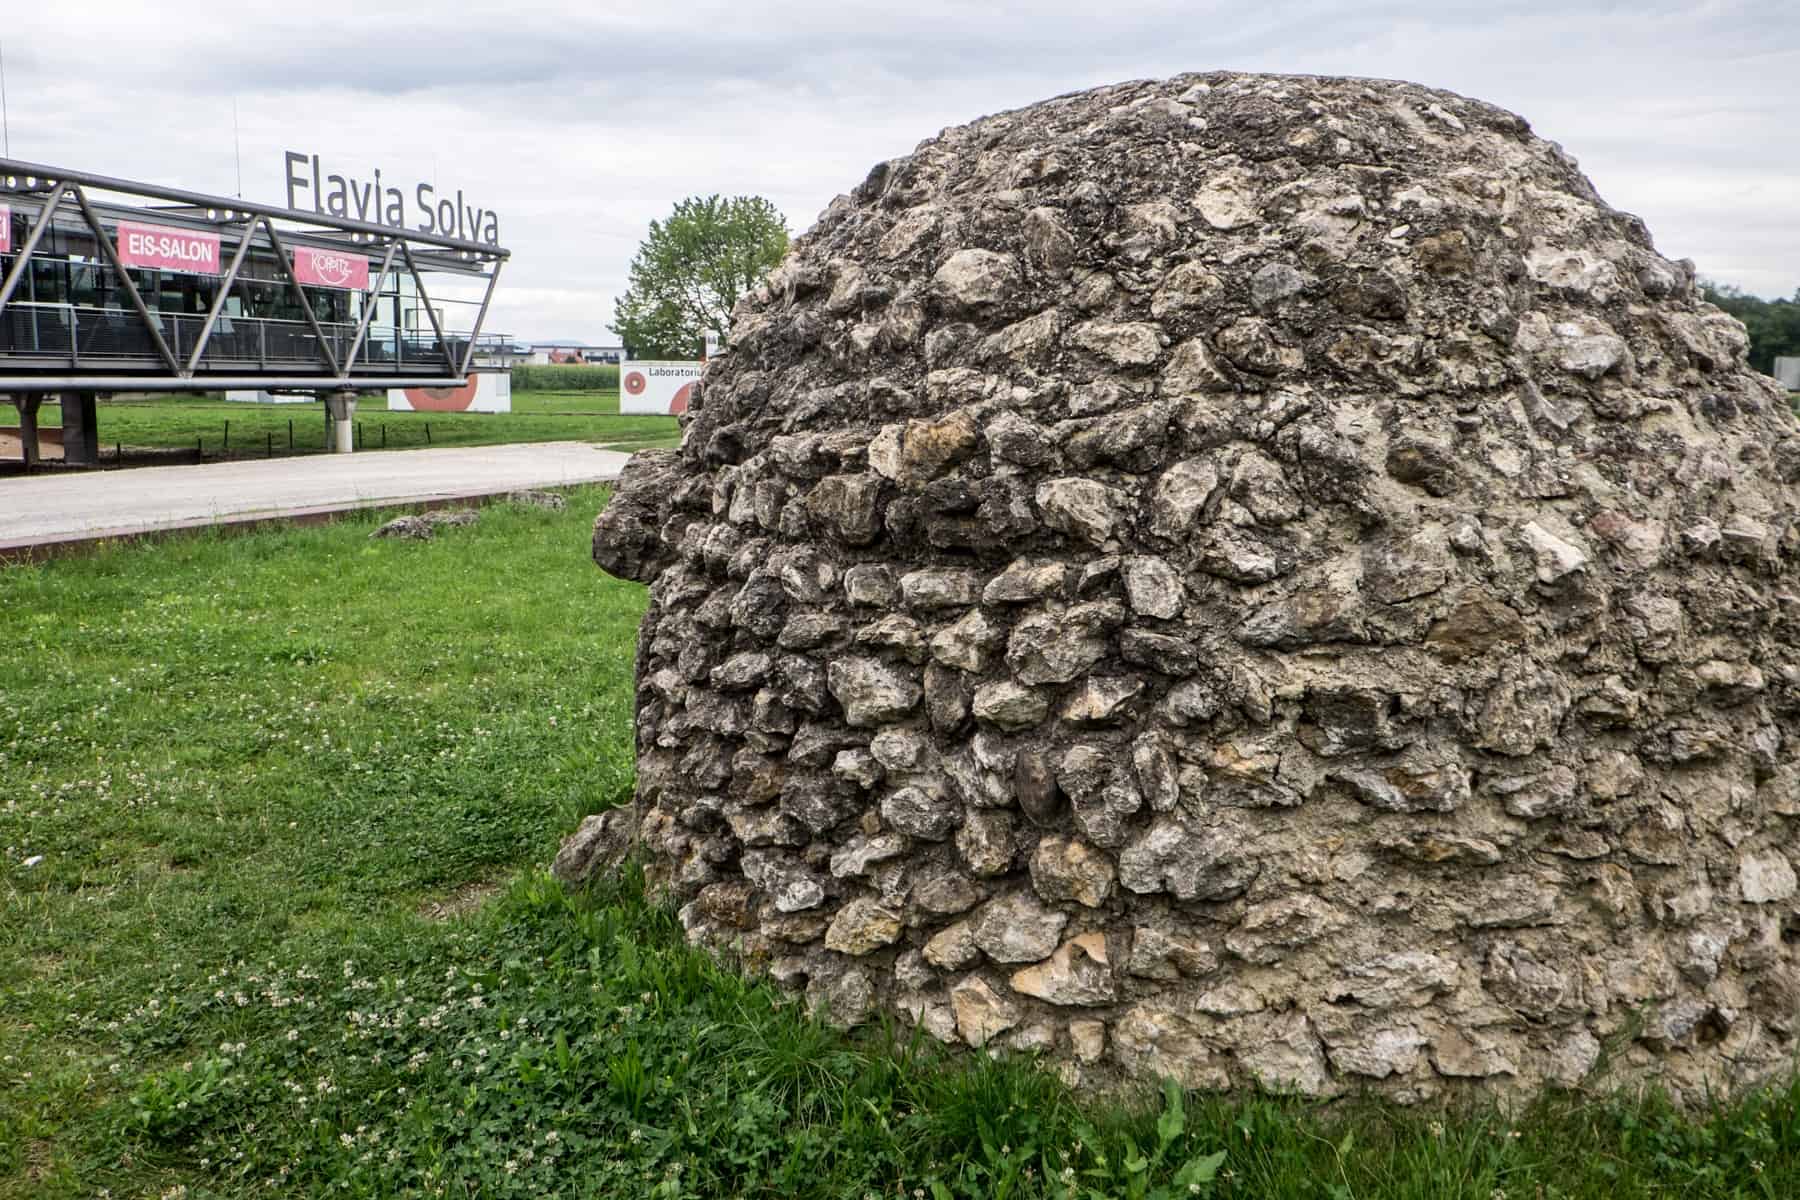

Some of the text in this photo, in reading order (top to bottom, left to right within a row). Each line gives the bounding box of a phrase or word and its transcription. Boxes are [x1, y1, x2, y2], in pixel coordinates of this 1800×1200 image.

[286, 151, 500, 248] Flavia Solva
[128, 233, 213, 263] EIS-SALON
